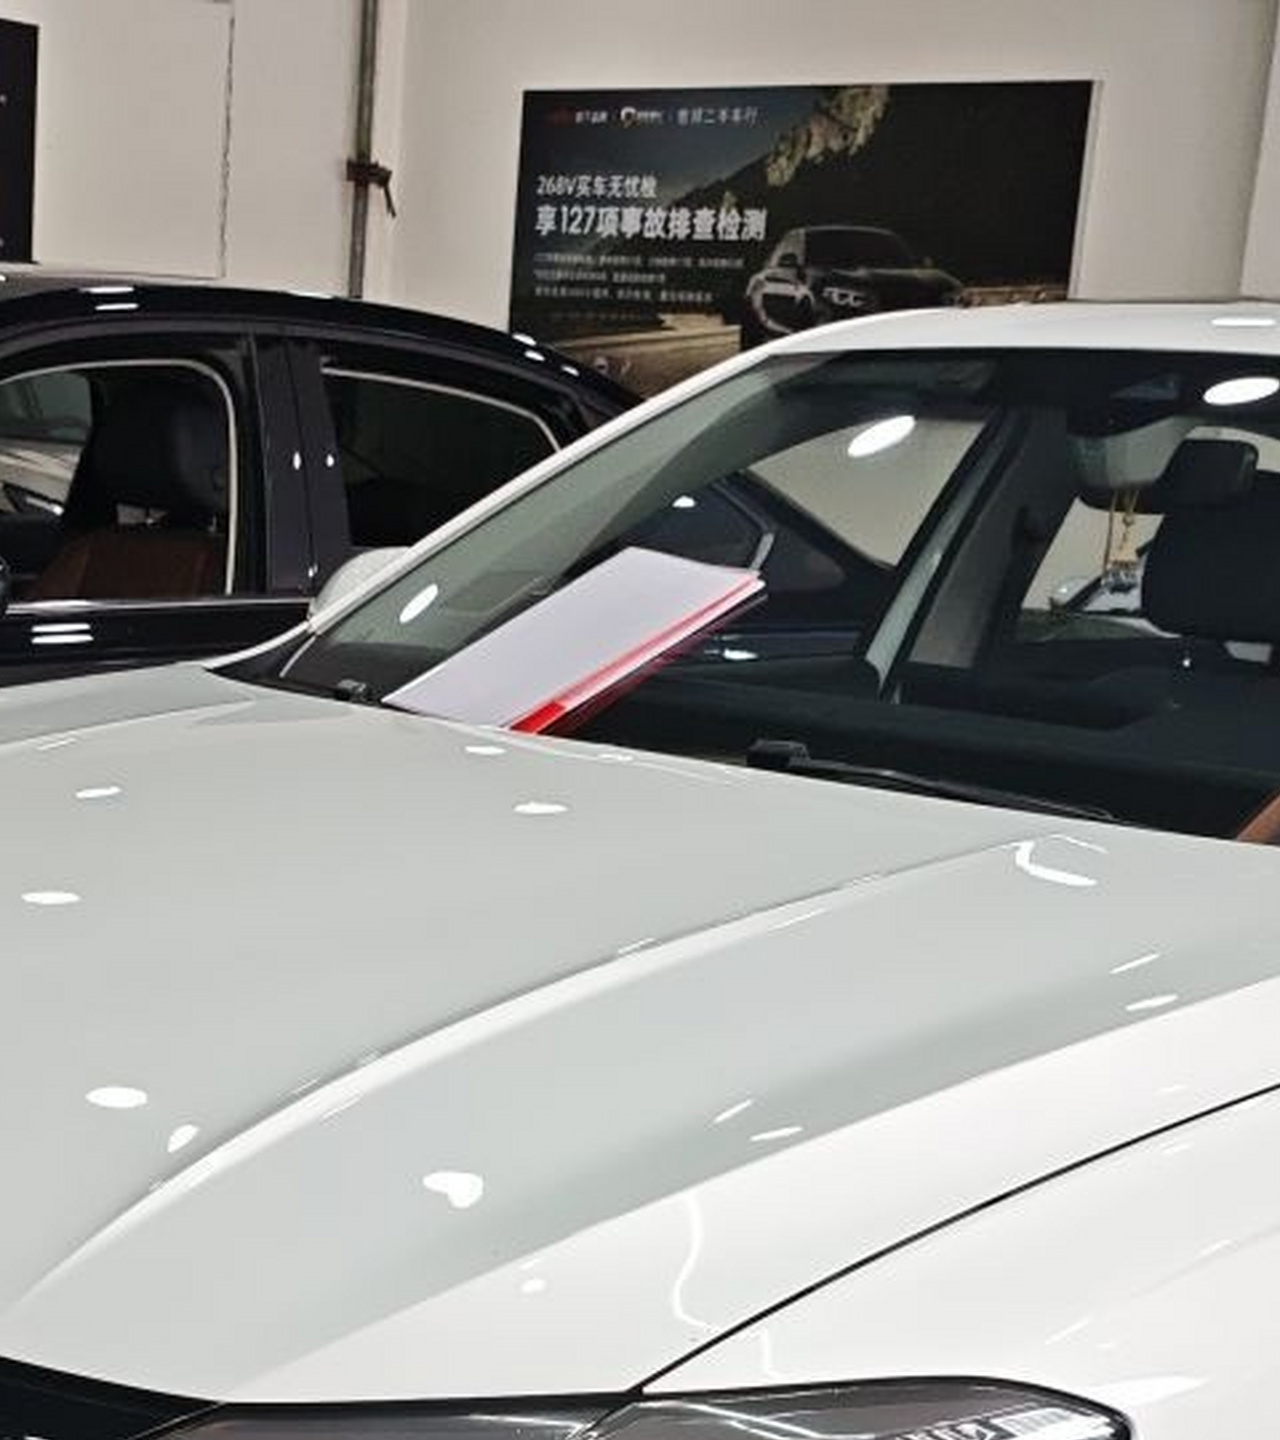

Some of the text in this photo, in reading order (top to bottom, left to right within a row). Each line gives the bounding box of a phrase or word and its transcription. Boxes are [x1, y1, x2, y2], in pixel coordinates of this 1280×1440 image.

[535, 205, 767, 241] 享127项事故排查检测
